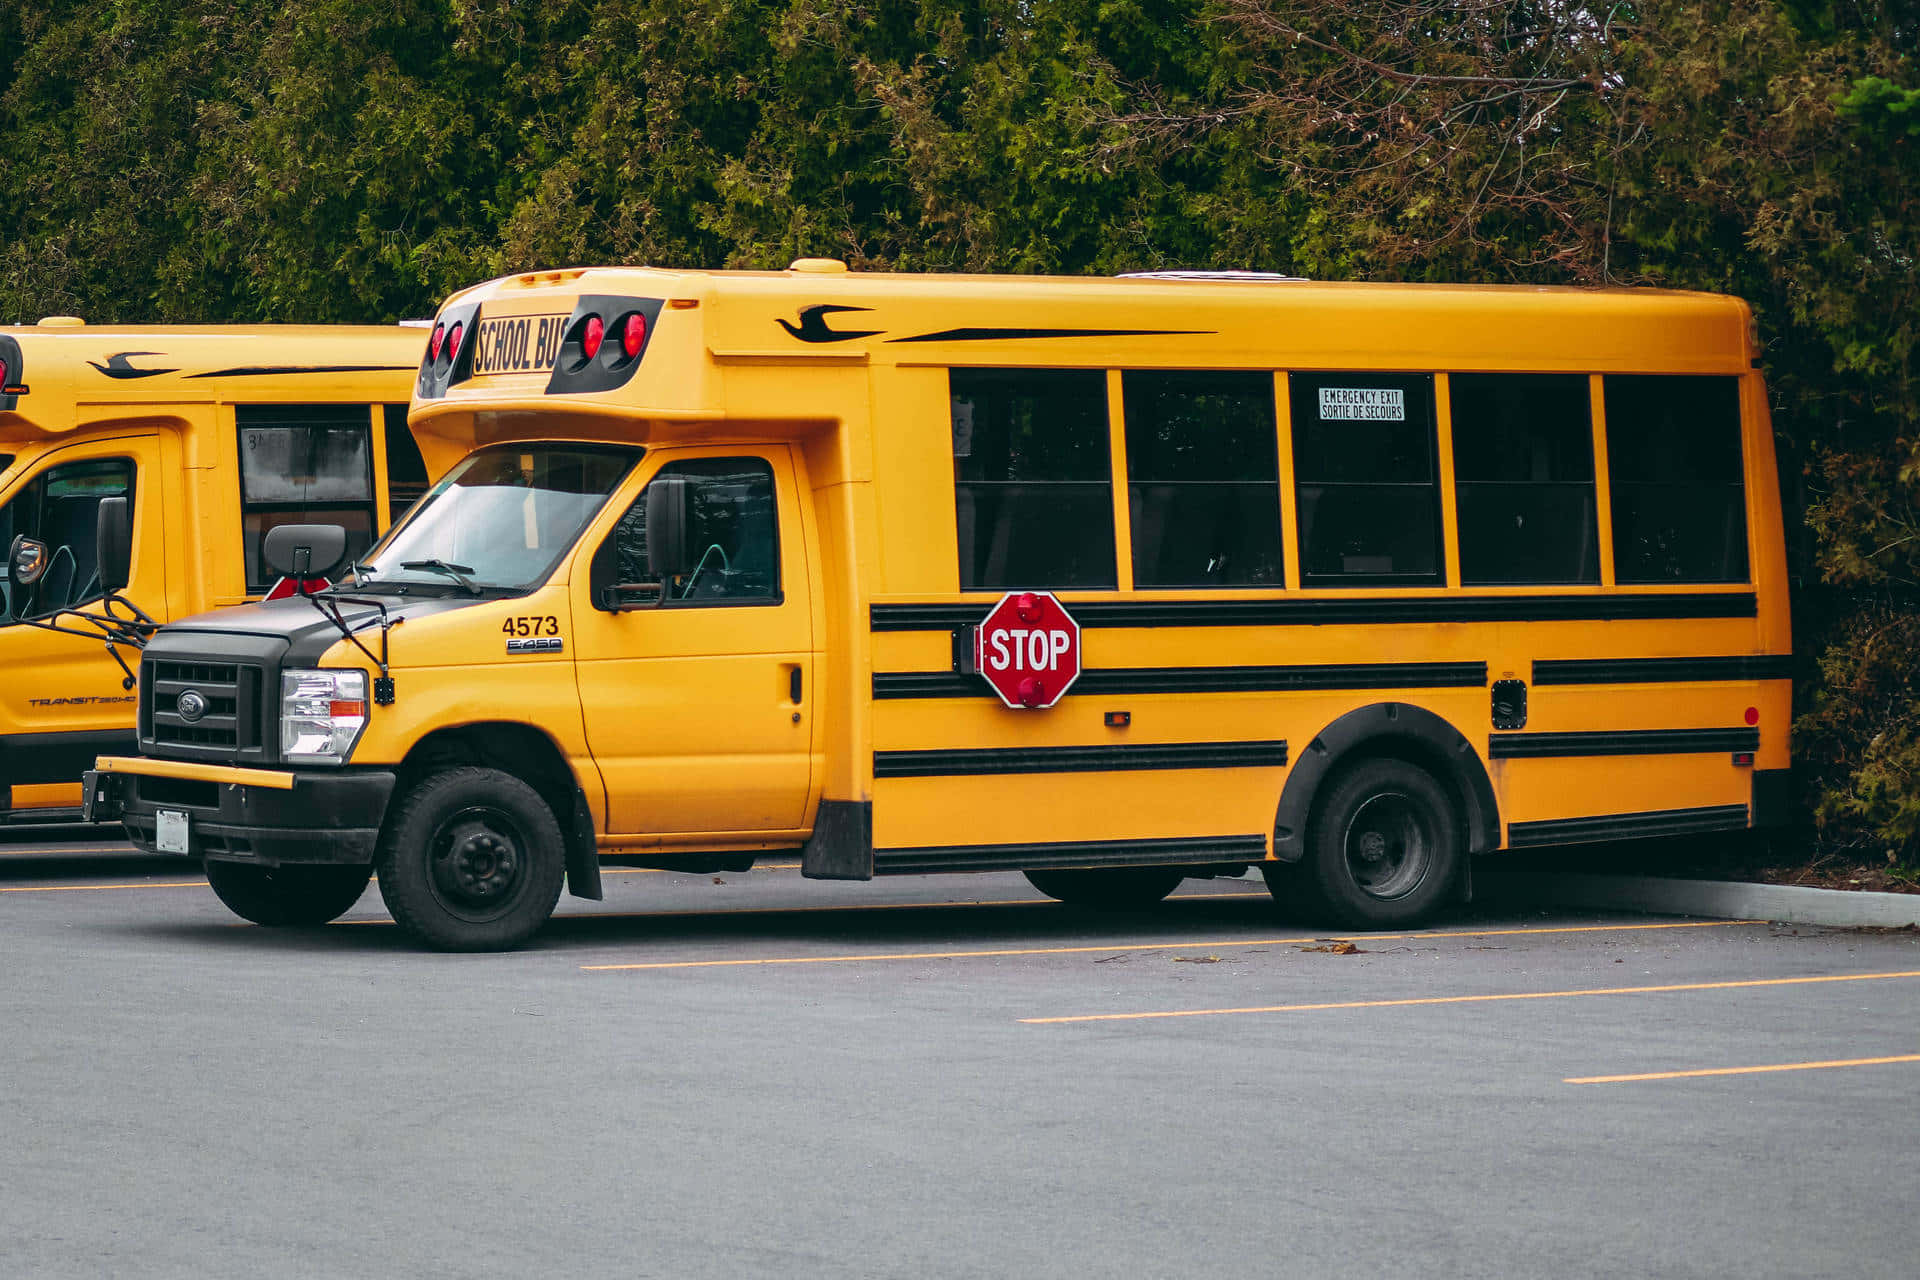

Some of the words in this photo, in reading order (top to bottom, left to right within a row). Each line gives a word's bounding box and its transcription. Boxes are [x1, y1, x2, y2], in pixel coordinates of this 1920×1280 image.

[475, 319, 531, 372] SCHOOL
[1324, 390, 1376, 404] EMERGENCY
[1380, 391, 1399, 404] EXIT
[1322, 405, 1350, 418] SORTIE
[1353, 405, 1364, 418] DE
[1365, 405, 1402, 419] SECOURS
[502, 616, 559, 636] 4573
[990, 628, 1070, 671] STOP
[29, 696, 98, 707] TRANSIT
